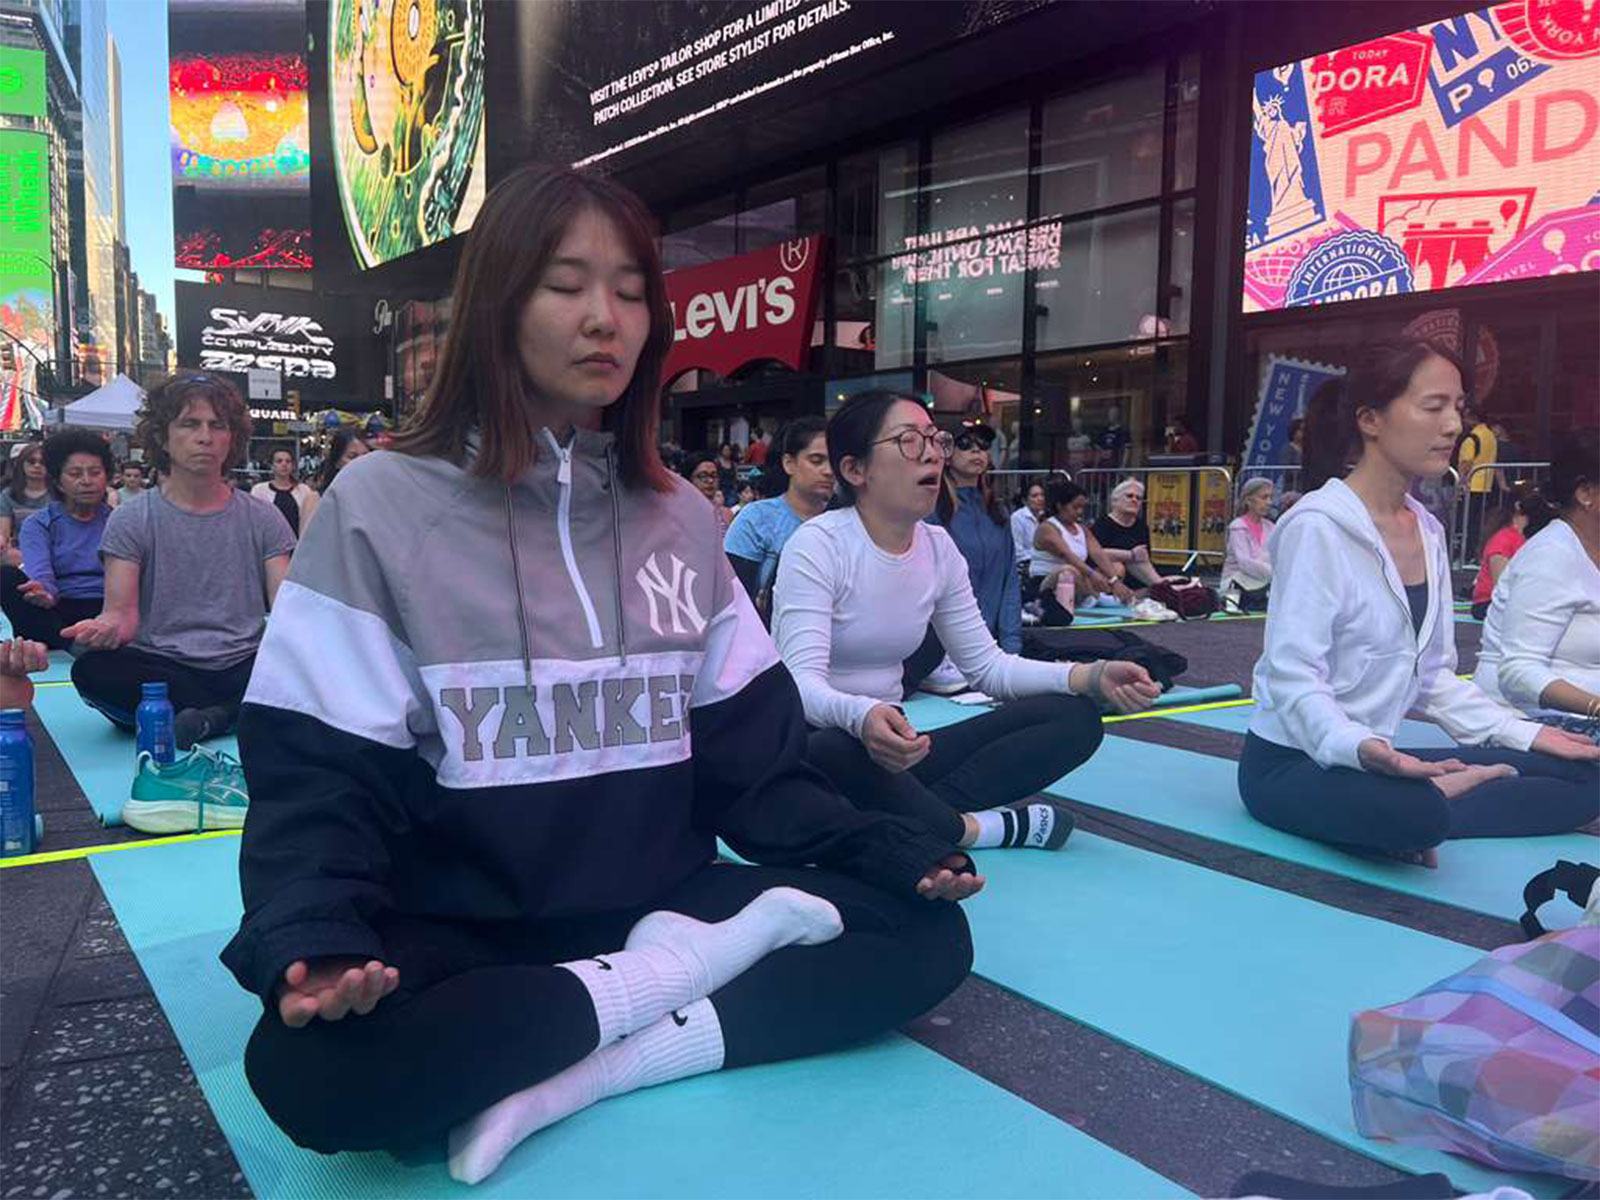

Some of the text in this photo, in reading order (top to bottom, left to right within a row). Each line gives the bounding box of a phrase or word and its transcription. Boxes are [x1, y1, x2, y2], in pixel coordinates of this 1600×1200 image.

[590, 85, 611, 106] VISIT
[610, 76, 628, 97] THE
[660, 45, 693, 71] TAILOR
[693, 29, 722, 56] SHOP
[722, 18, 745, 41] FOR
[745, 13, 754, 31] A
[755, 0, 801, 26] LIMITED
[593, 102, 620, 126] PATCH
[676, 66, 695, 88] SEE
[695, 51, 728, 79] STORE
[728, 30, 771, 63] STYLIST
[772, 19, 796, 44] FOR
[798, 0, 851, 32] DETAILS.
[1352, 49, 1388, 60] TODAY
[1506, 56, 1538, 79] 06
[1316, 62, 1410, 92] DORA
[1301, 244, 1388, 287] INTERNATIONAL
[1269, 373, 1291, 416] NEW
[635, 552, 708, 636] NY
